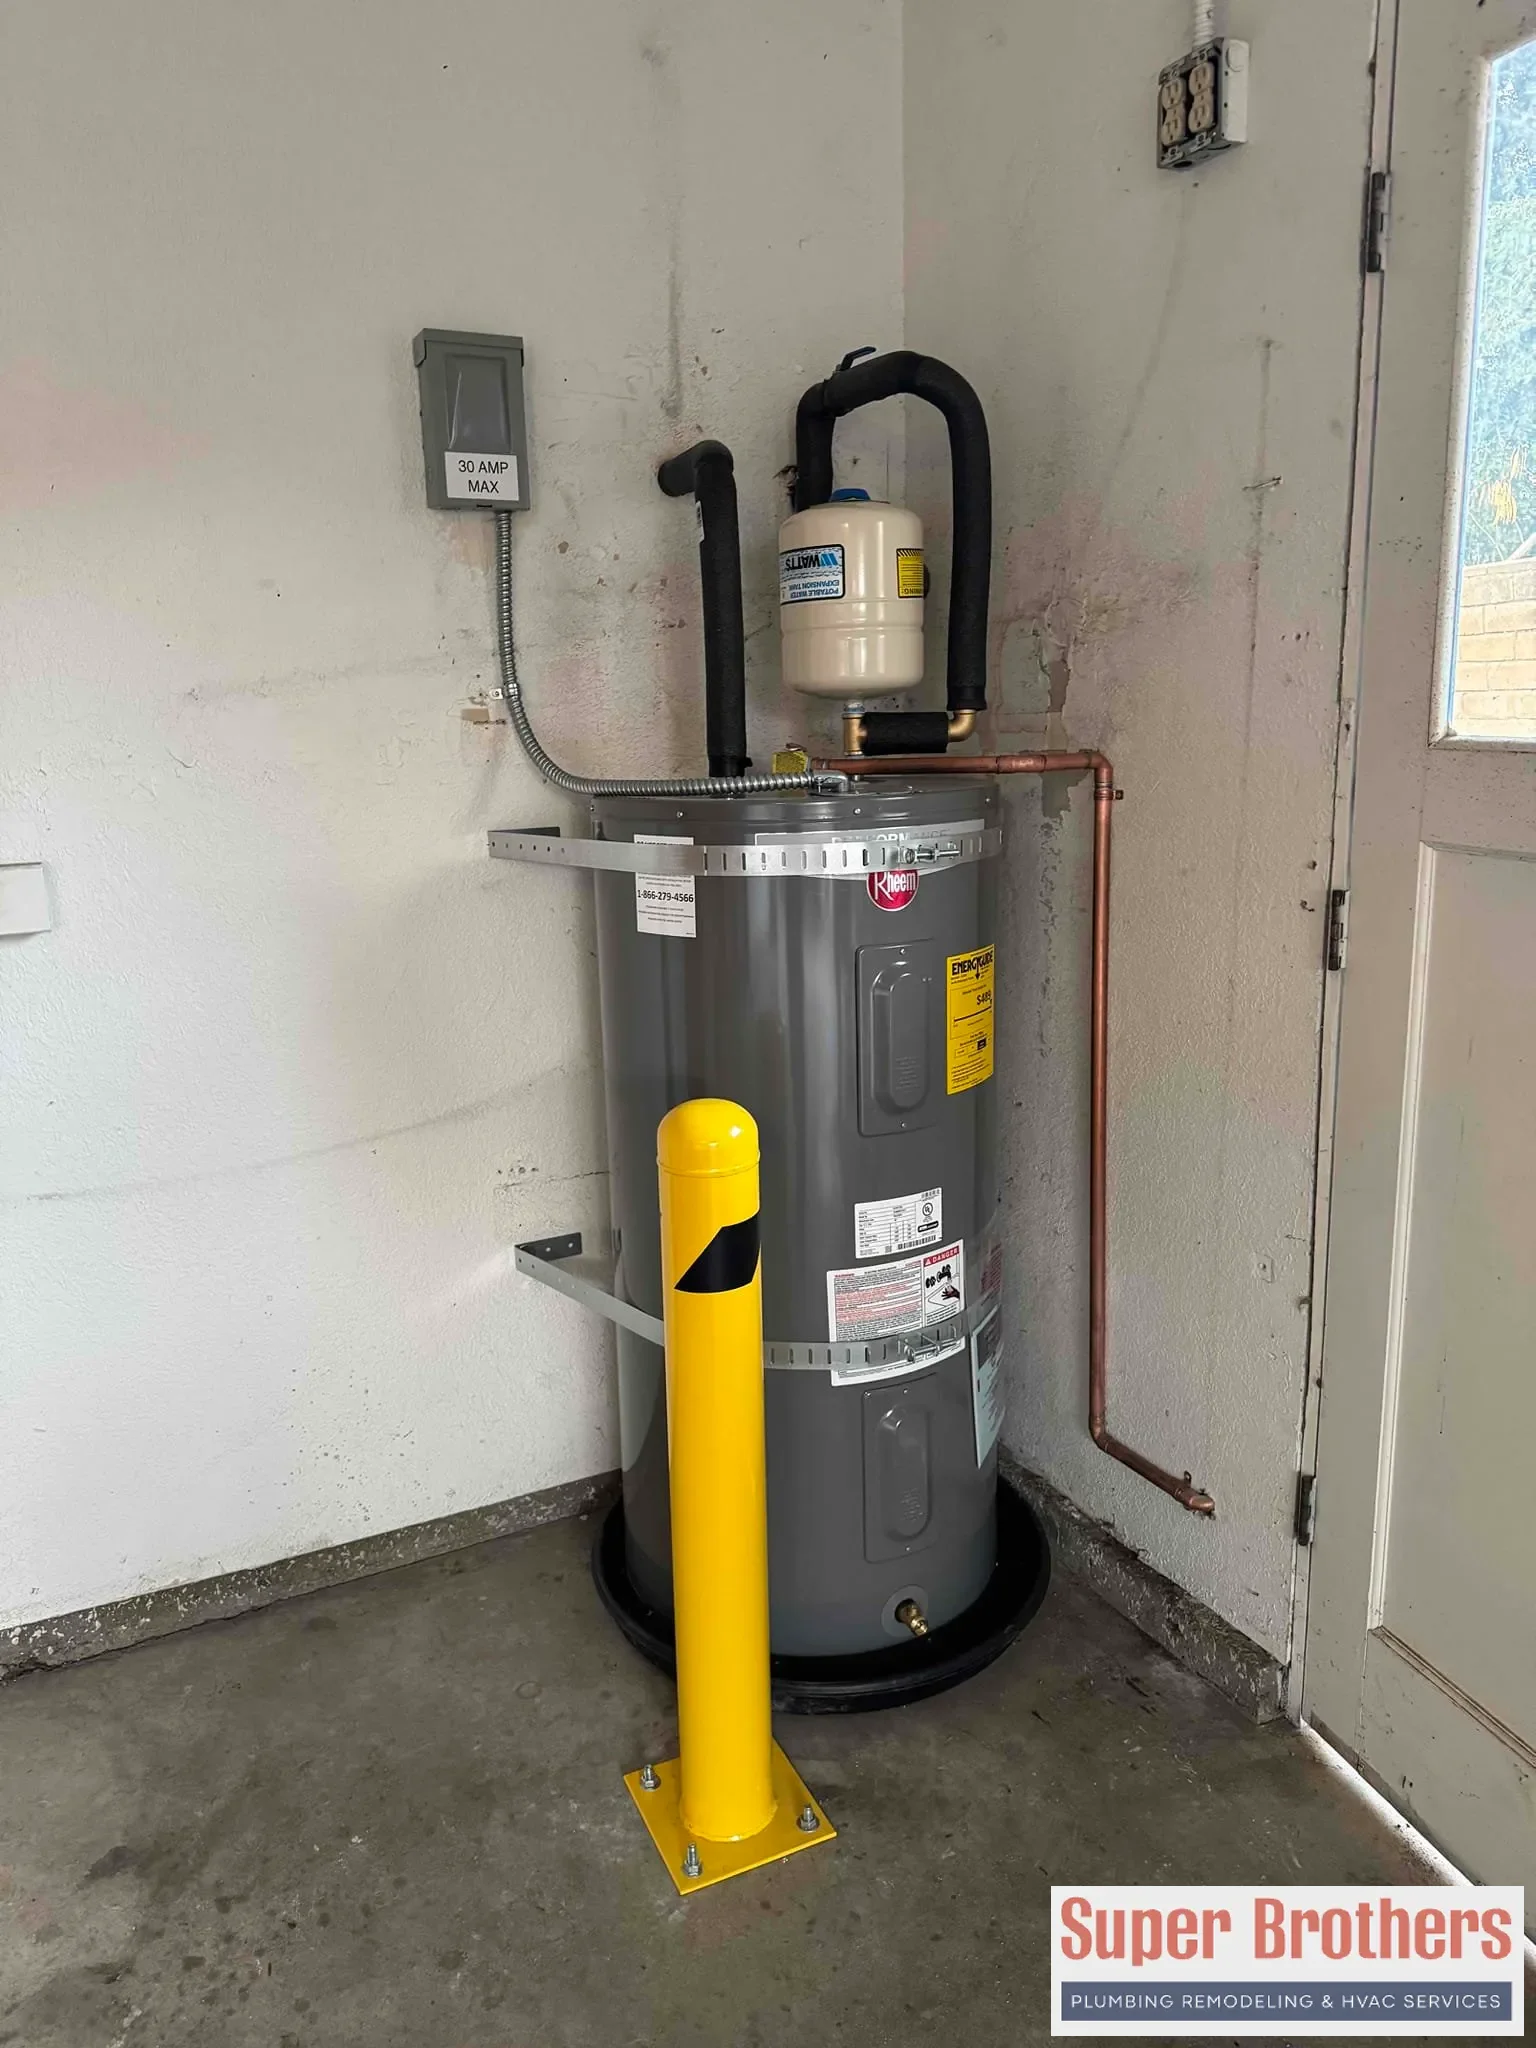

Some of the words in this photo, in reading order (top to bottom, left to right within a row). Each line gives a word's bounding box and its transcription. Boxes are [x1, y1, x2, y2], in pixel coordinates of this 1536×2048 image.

[458, 460, 475, 473] 30
[478, 461, 509, 474] AMP
[468, 479, 500, 493] MAX
[785, 555, 821, 571] WATTS
[807, 587, 839, 596] POTABLE
[874, 871, 917, 902] Rheem
[637, 889, 694, 903] 1-866-279-4566
[932, 1247, 958, 1263] DANGER
